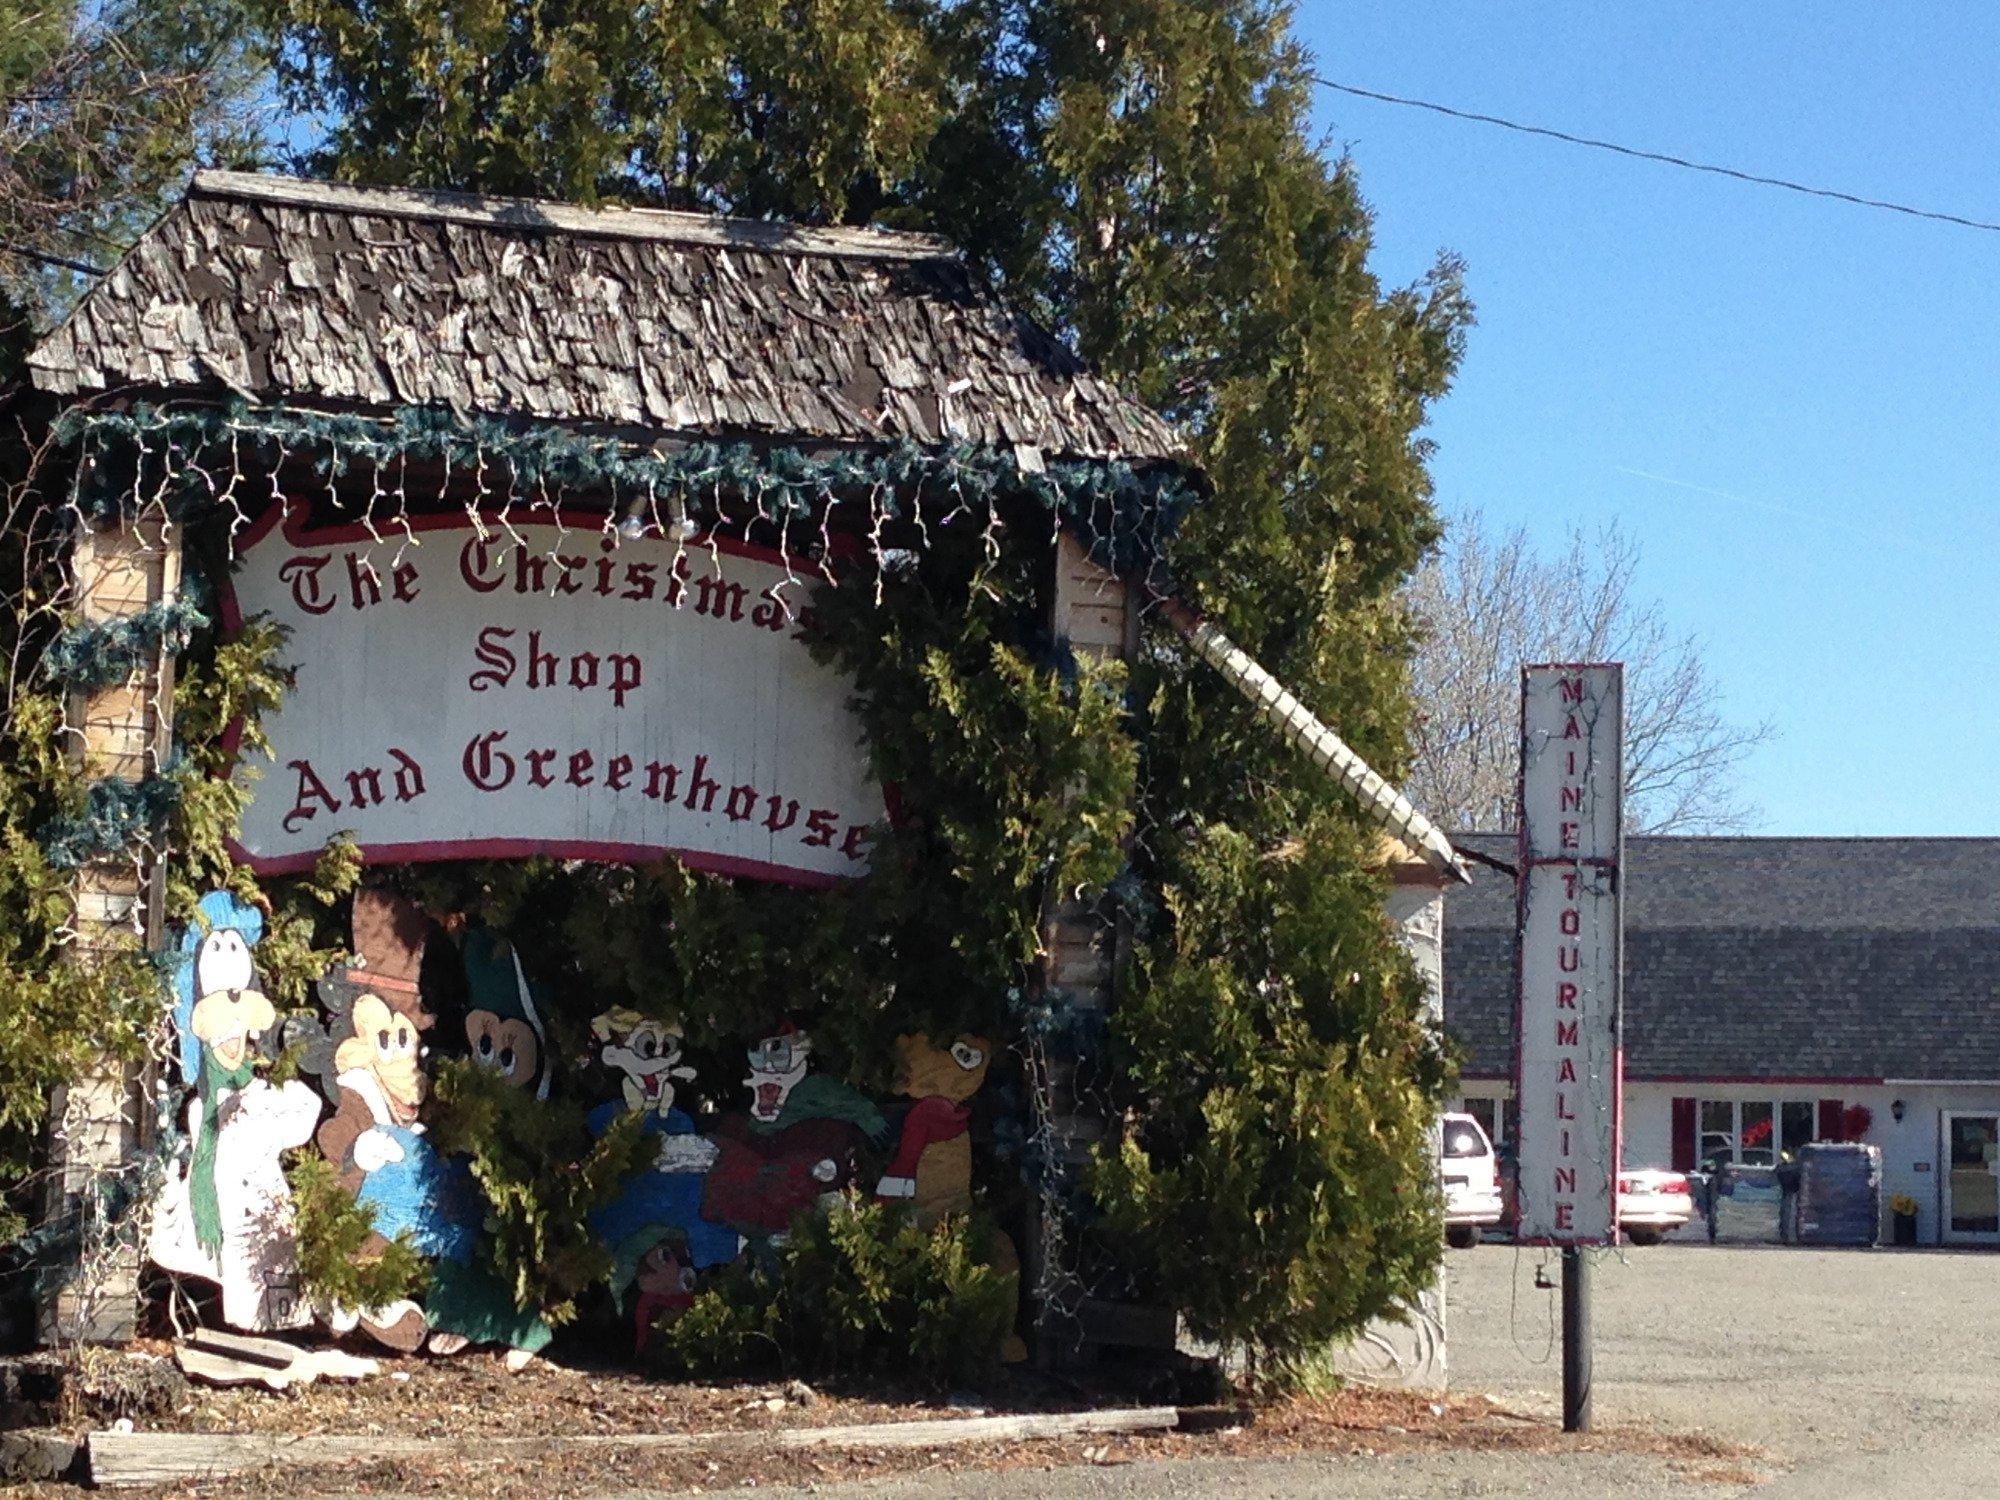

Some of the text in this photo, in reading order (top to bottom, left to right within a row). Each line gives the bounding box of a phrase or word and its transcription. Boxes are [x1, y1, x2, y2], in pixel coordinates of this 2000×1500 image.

[278, 552, 421, 615] The
[469, 626, 642, 707] Shop
[283, 748, 426, 834] And
[1555, 677, 1584, 1231] MAINE TOURMALINE
